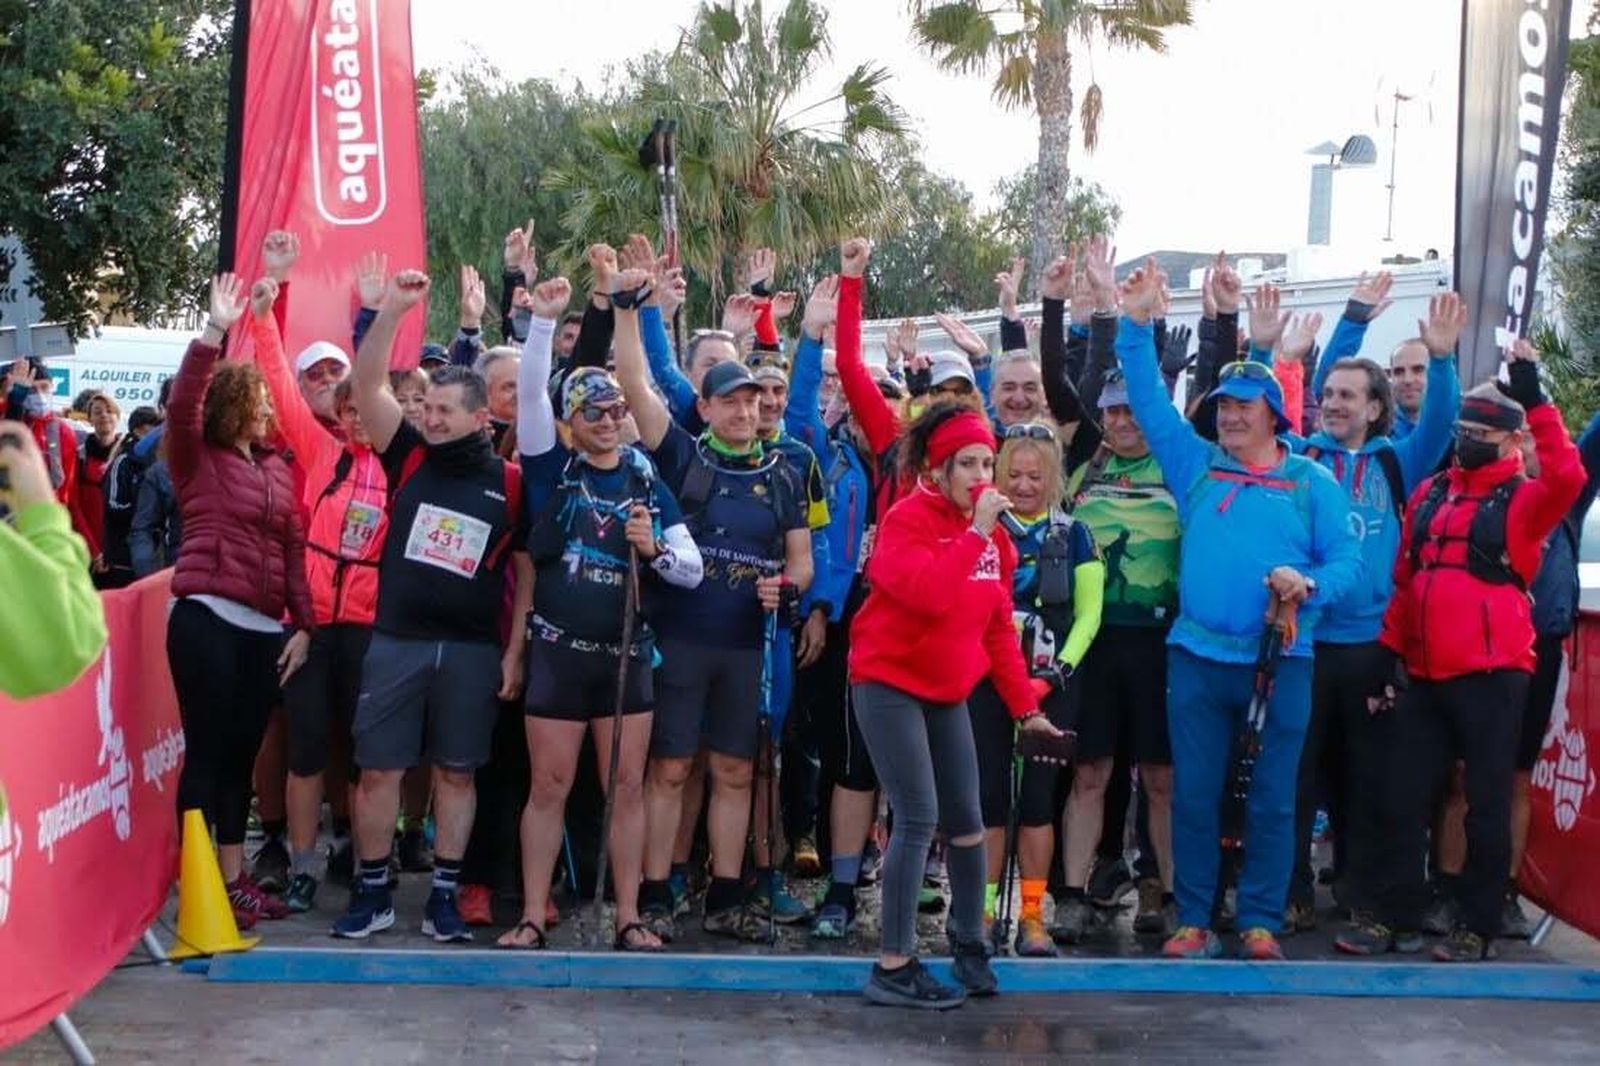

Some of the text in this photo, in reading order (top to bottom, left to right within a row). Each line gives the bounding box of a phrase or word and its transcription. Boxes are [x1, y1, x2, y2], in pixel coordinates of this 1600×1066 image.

[1495, 0, 1548, 384] tacamo
[81, 369, 152, 383] ALQUILER
[115, 387, 153, 401] 950
[427, 528, 464, 551] 431
